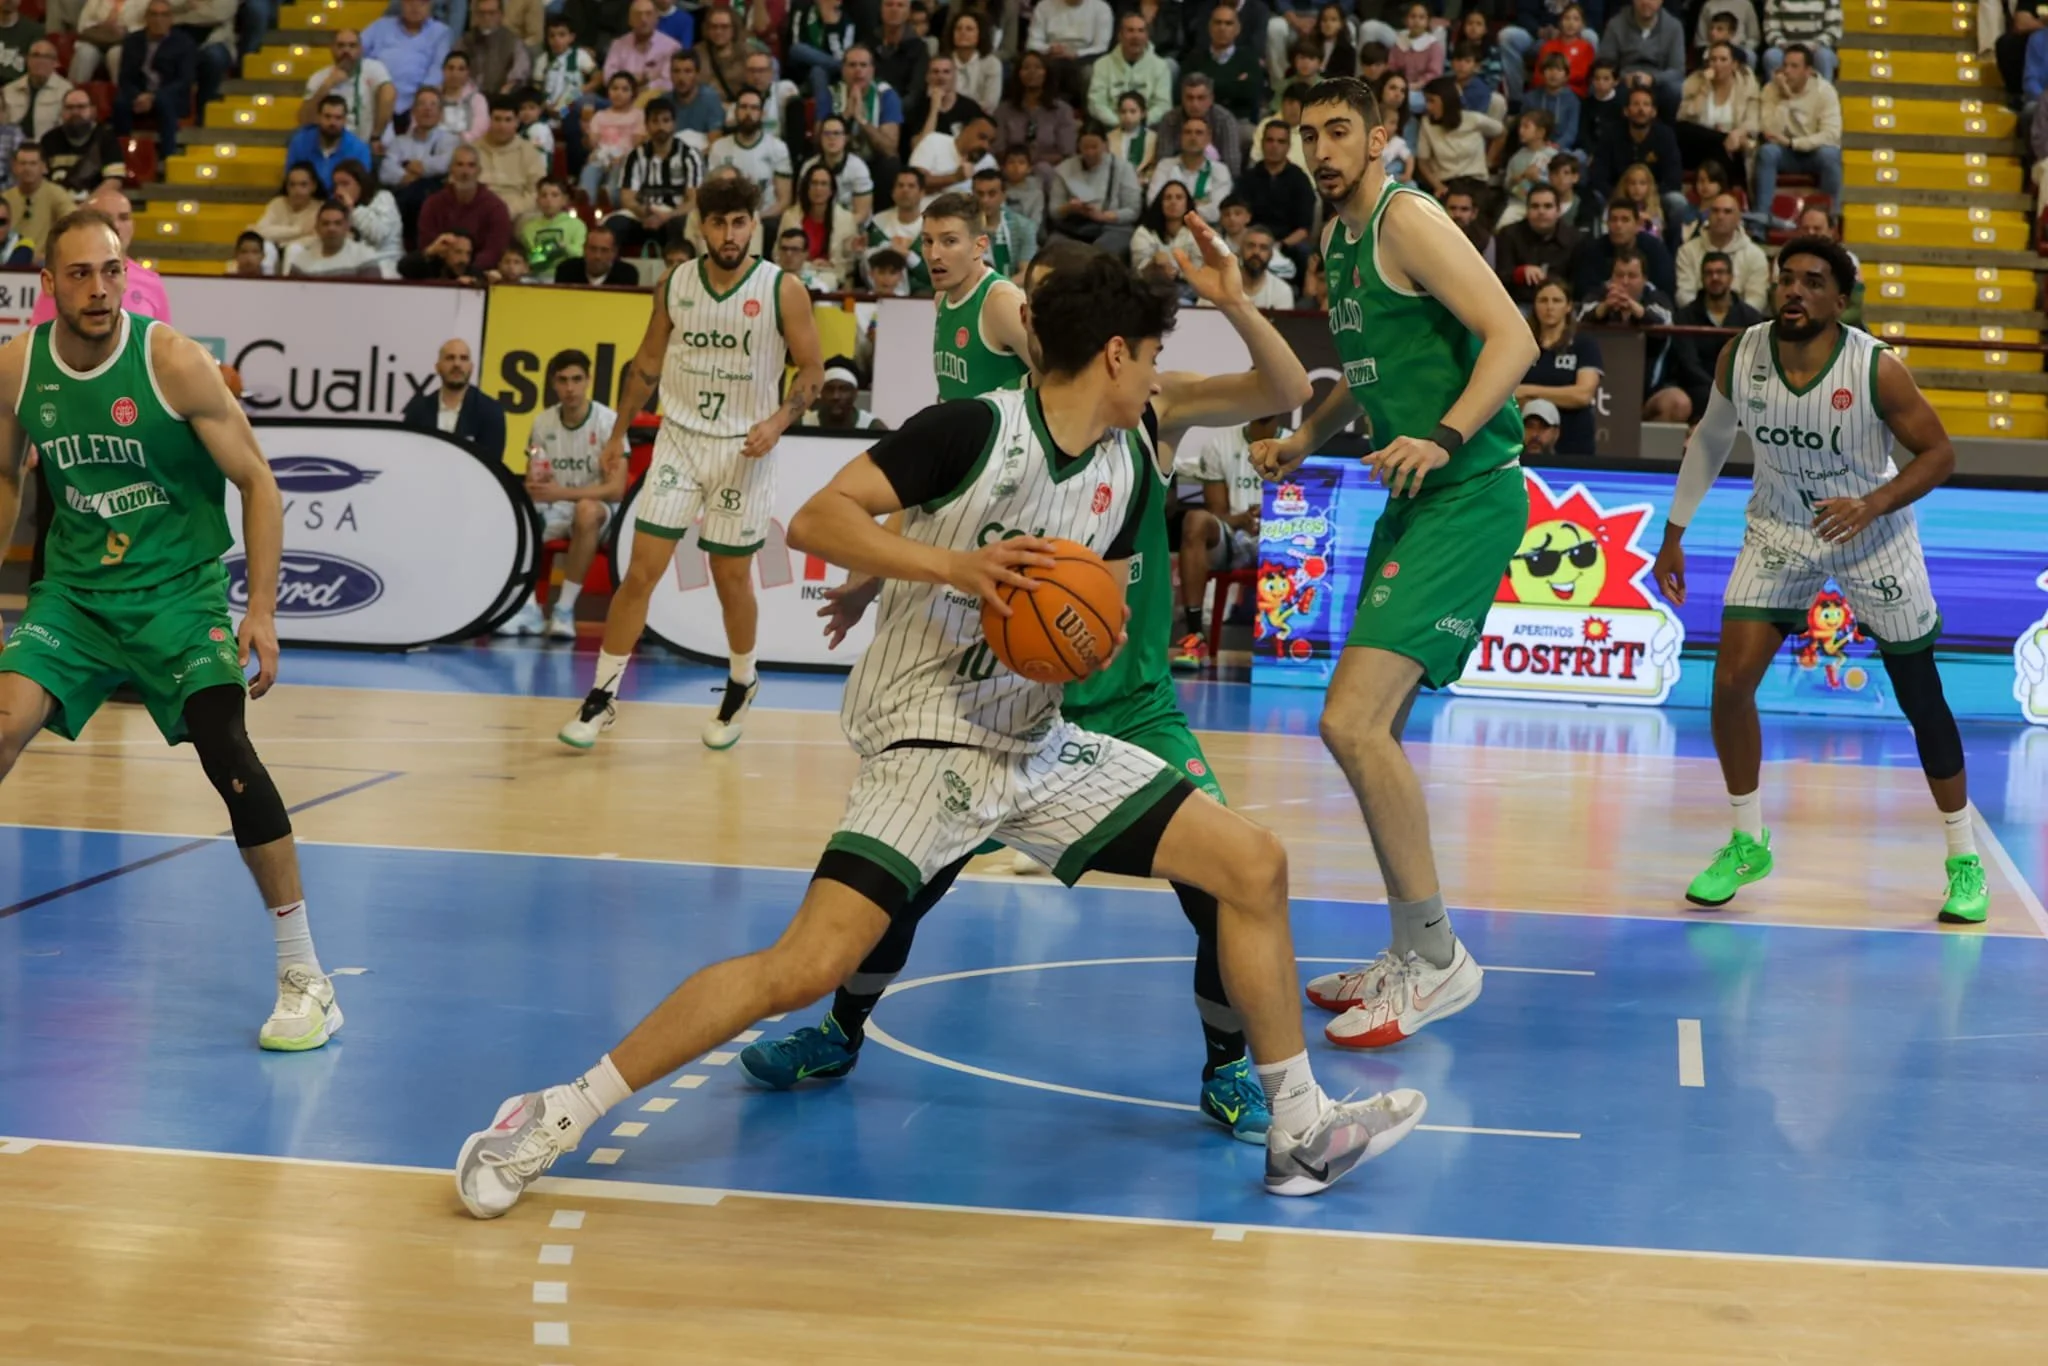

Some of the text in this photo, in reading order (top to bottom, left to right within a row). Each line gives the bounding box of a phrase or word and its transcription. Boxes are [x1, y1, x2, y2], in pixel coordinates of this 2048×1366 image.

[682, 330, 737, 349] coto
[233, 339, 437, 413] Cualix
[698, 391, 725, 421] 27
[41, 434, 146, 469] TOLEDO
[1755, 425, 1823, 449] coto
[101, 530, 129, 566] 9
[1513, 624, 1574, 638] APERITIVOS
